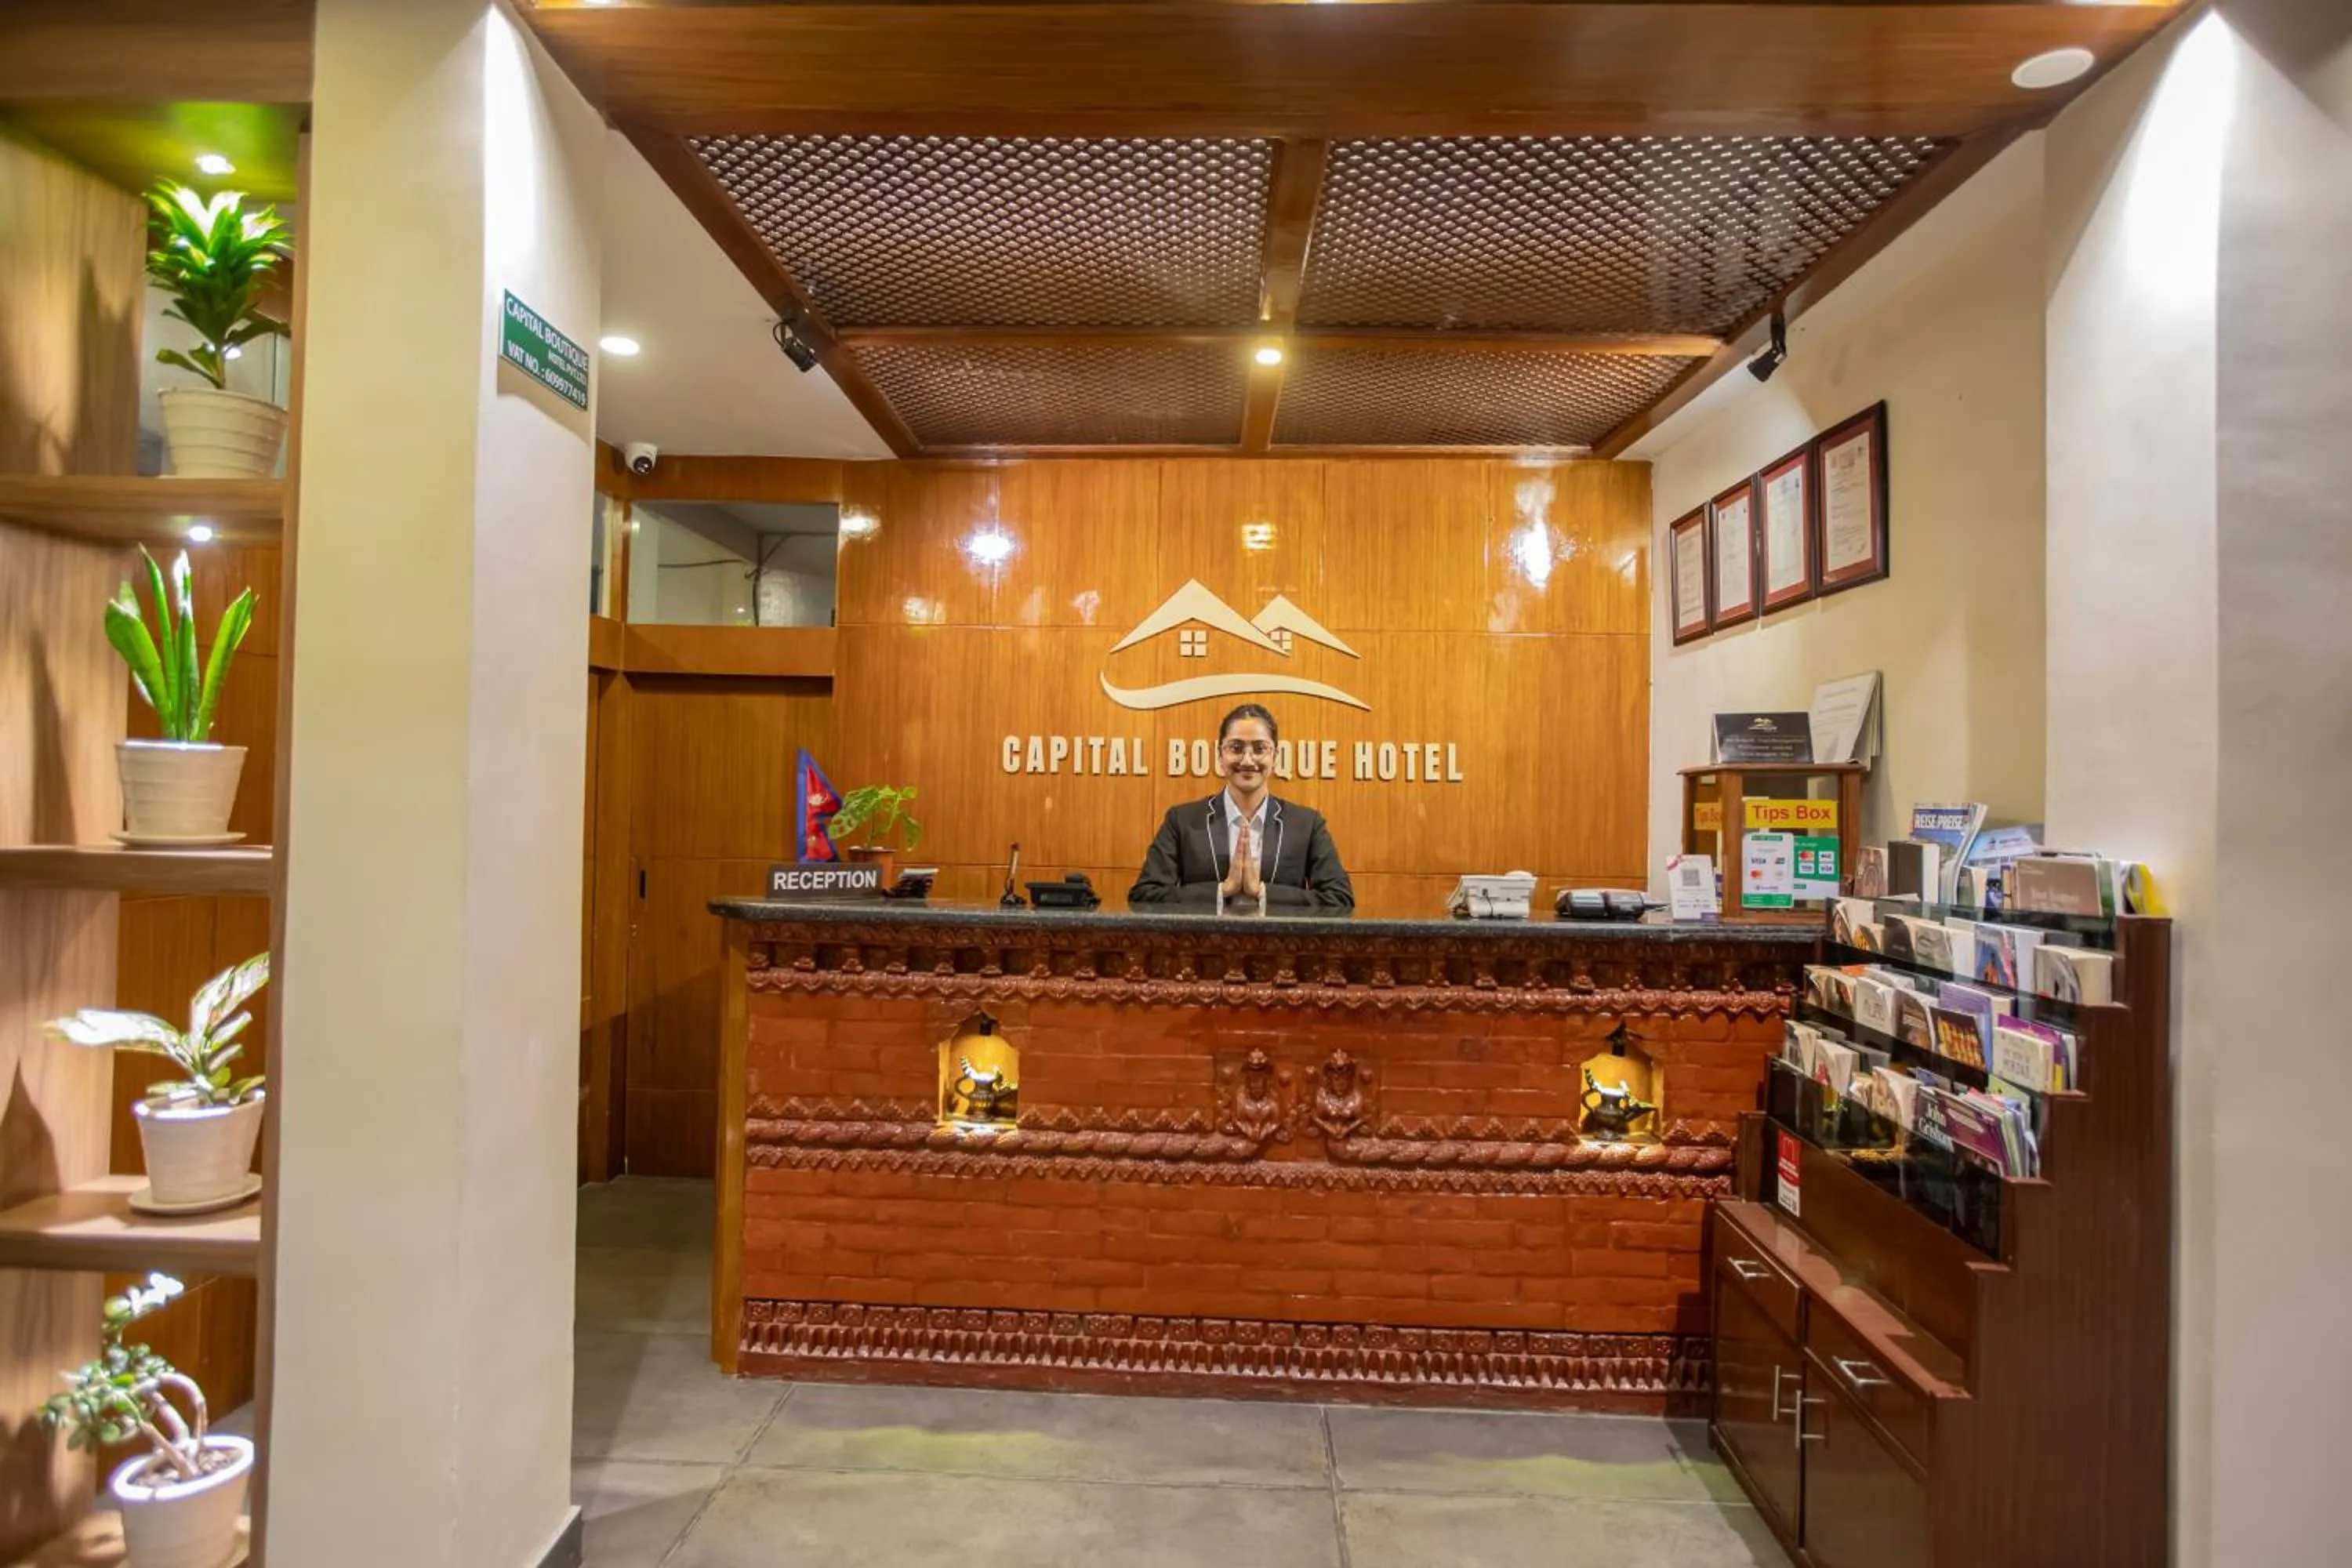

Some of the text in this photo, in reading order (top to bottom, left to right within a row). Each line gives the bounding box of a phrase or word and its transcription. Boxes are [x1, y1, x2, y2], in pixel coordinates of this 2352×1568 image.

[506, 297, 588, 372] CAPITAL BOUTIQUE
[508, 339, 524, 365] VAT
[1003, 735, 1465, 783] CAPITAL BOQUE HOTEL
[1751, 805, 1831, 823] Tips Box
[774, 869, 877, 891] RECEPTION
